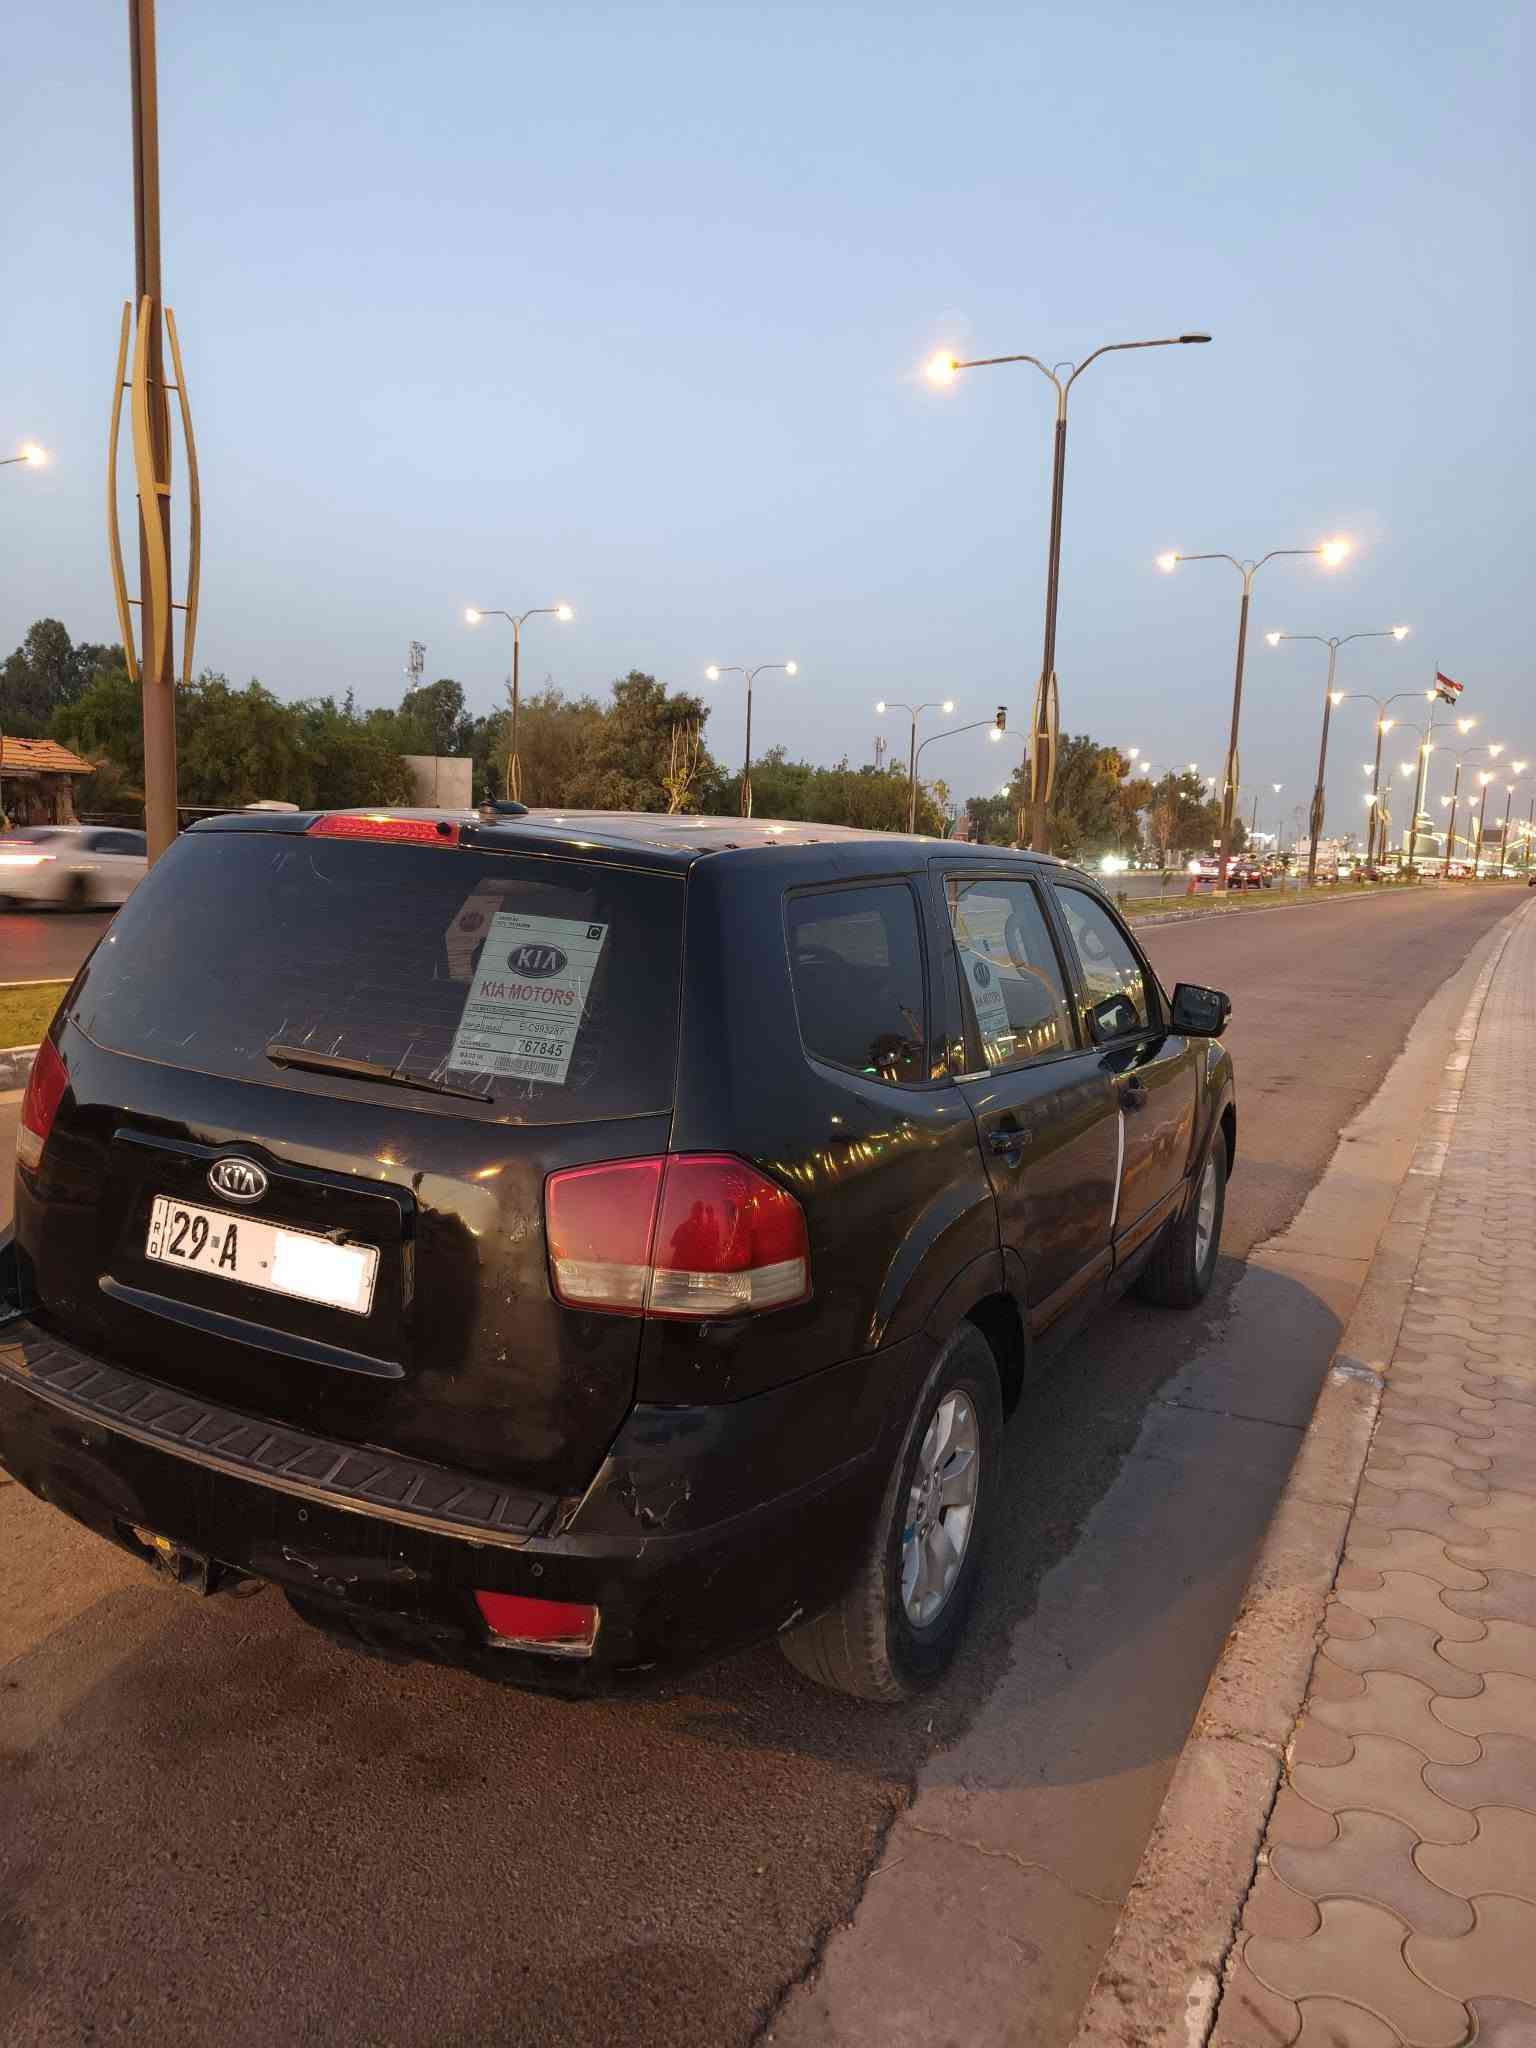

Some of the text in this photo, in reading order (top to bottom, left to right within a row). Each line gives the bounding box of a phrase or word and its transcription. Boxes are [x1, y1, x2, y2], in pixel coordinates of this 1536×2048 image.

[517, 949, 557, 969] KIA
[480, 980, 576, 1005] KIA MOTORS
[219, 1165, 256, 1193] KIA
[169, 1211, 238, 1271] 29 A
